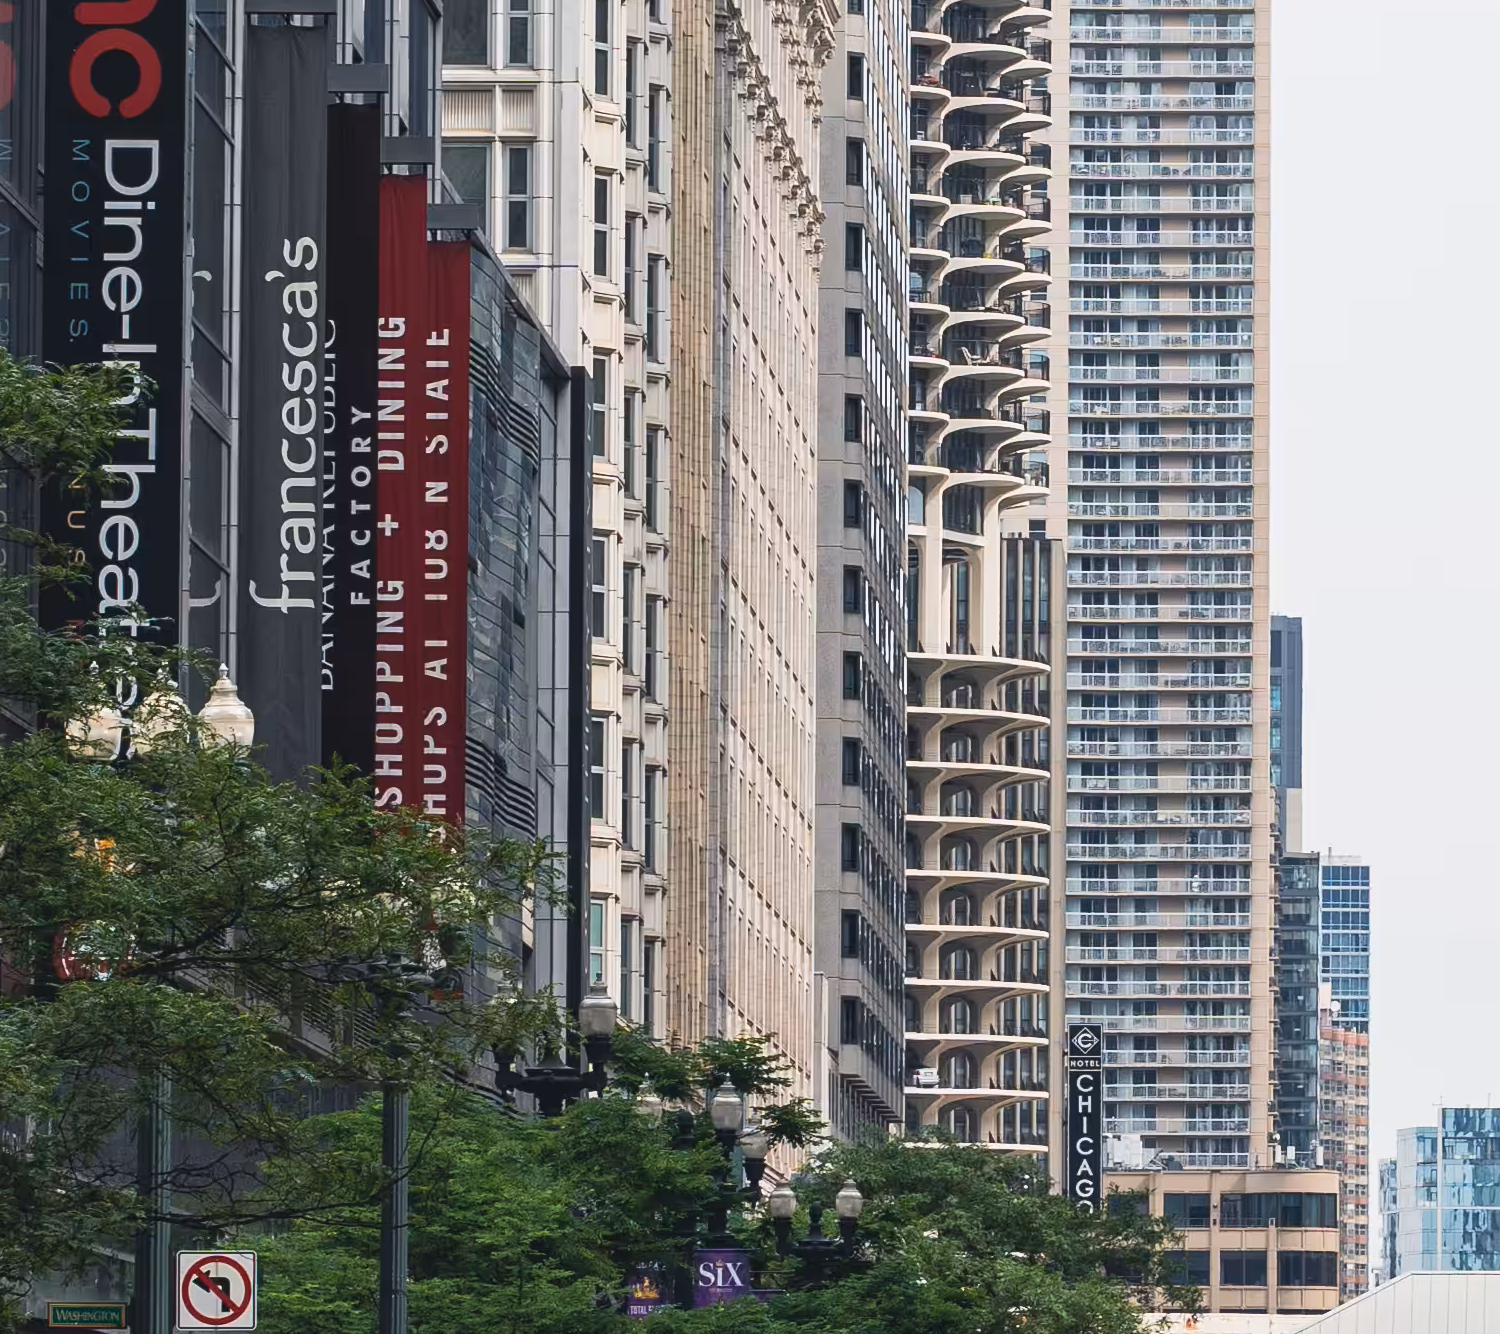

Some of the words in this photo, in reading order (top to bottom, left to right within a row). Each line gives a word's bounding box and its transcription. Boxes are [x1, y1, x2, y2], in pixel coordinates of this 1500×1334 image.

[249, 236, 318, 614] francesca's
[377, 317, 405, 471] DINING
[350, 405, 372, 605] FACTORY
[375, 580, 405, 808] SHOPPING
[1070, 1060, 1100, 1068] HOTEL
[1075, 1074, 1094, 1214] CHICAGO
[56, 1307, 120, 1322] WASHINGTON
[630, 1305, 648, 1315] TOTAL
[699, 1261, 745, 1287] SIX
